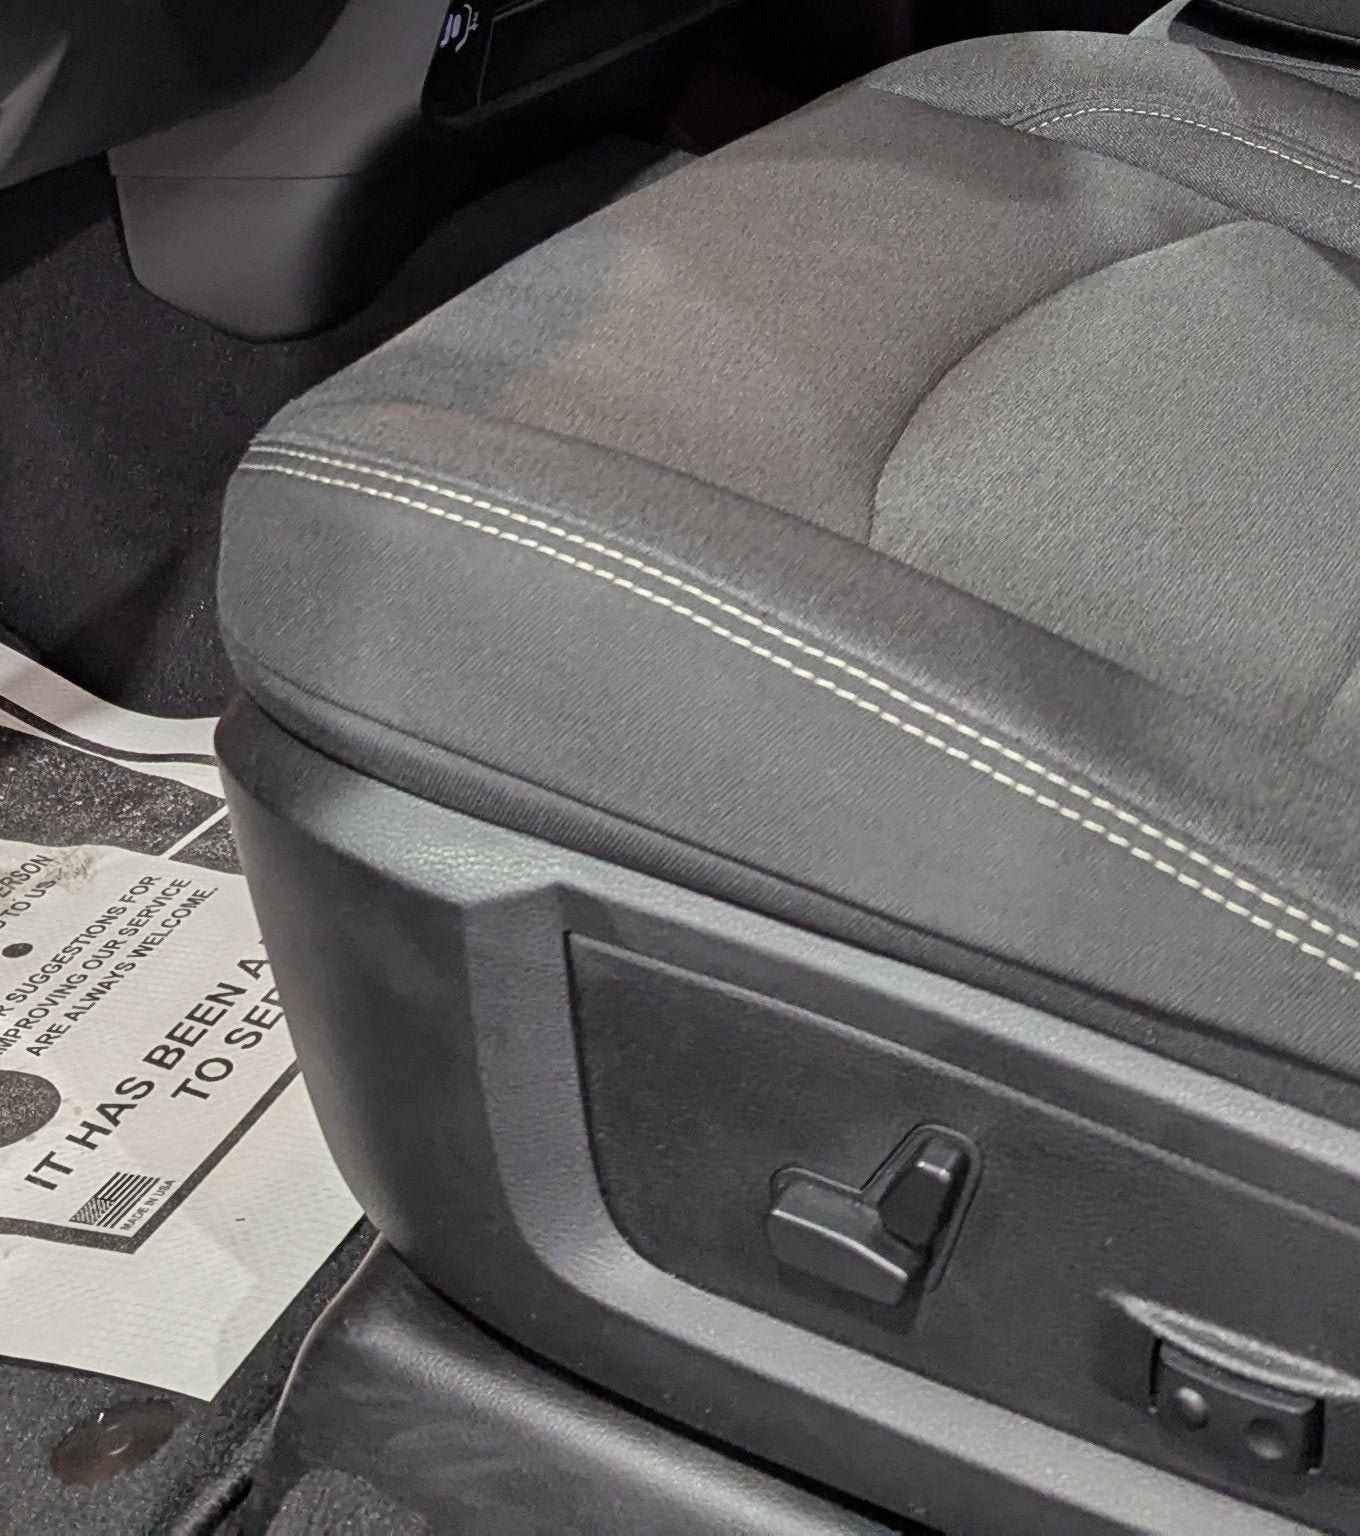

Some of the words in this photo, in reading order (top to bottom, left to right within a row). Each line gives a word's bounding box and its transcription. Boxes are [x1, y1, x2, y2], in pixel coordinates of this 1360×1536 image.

[0, 901, 32, 917] TO
[6, 906, 128, 1003] SUGGESTIONS
[119, 875, 162, 904] FOR
[81, 938, 127, 971] OUR
[118, 878, 192, 937] SERVICE
[25, 1023, 71, 1057] ARE
[64, 961, 137, 1022] ALWAYS
[126, 887, 219, 958] WELCOME.
[24, 1150, 74, 1191] IT
[65, 1076, 155, 1151] HAS
[142, 982, 248, 1071] BEEN
[237, 959, 270, 981] A
[170, 1056, 235, 1100] TO
[119, 1207, 150, 1231] MADE
[153, 1180, 176, 1197] USA
